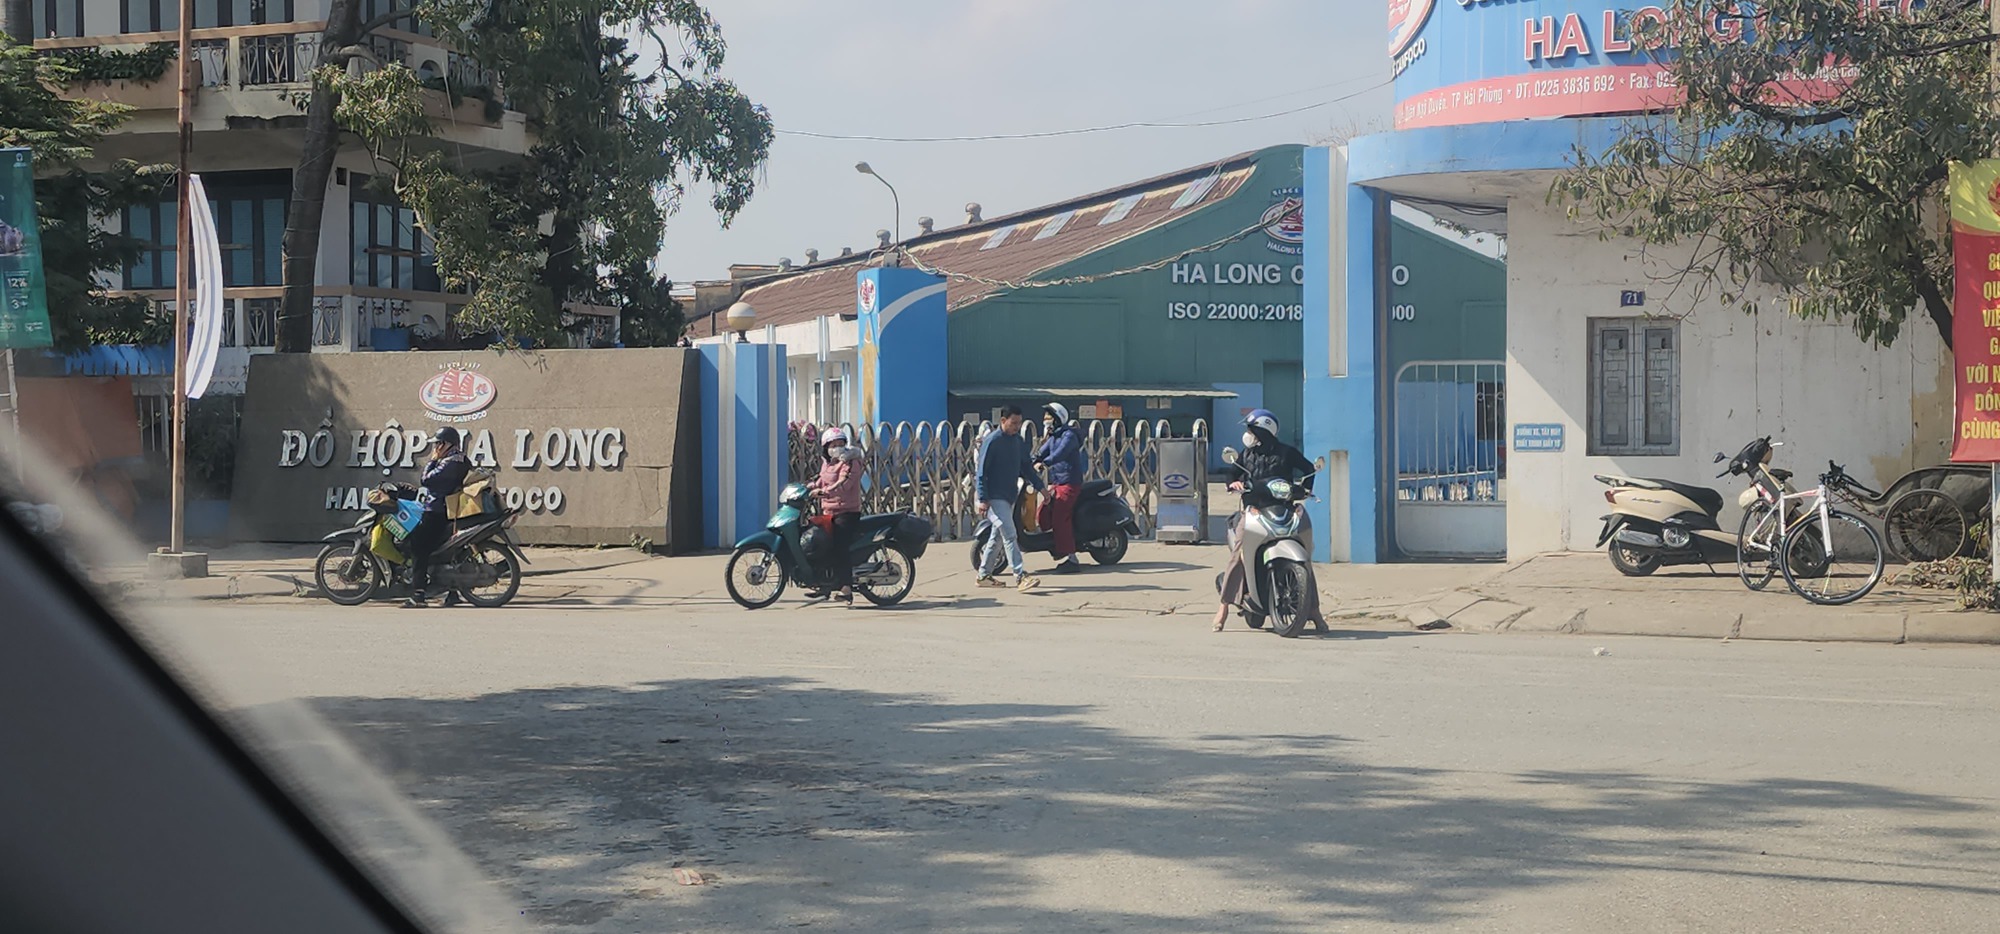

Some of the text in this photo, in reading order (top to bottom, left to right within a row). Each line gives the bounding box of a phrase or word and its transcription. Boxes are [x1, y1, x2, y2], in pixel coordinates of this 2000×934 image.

[1524, 13, 1590, 61] HA
[1452, 91, 1461, 108] TP
[1534, 79, 1559, 97] 0225
[1563, 77, 1590, 94] 3836
[1594, 74, 1614, 92] 692
[7, 277, 28, 288] 12%
[1172, 262, 1207, 284] HA
[1214, 262, 1281, 285] LONG
[1625, 292, 1639, 304] 71
[1168, 302, 1201, 320] ISO
[1206, 303, 1303, 321] 22000:2018
[1990, 336, 2000, 355] G
[1966, 362, 1989, 384] VỚI
[1961, 417, 2000, 439] CÙNG
[346, 417, 428, 477] HỘP
[511, 427, 624, 468] LONG
